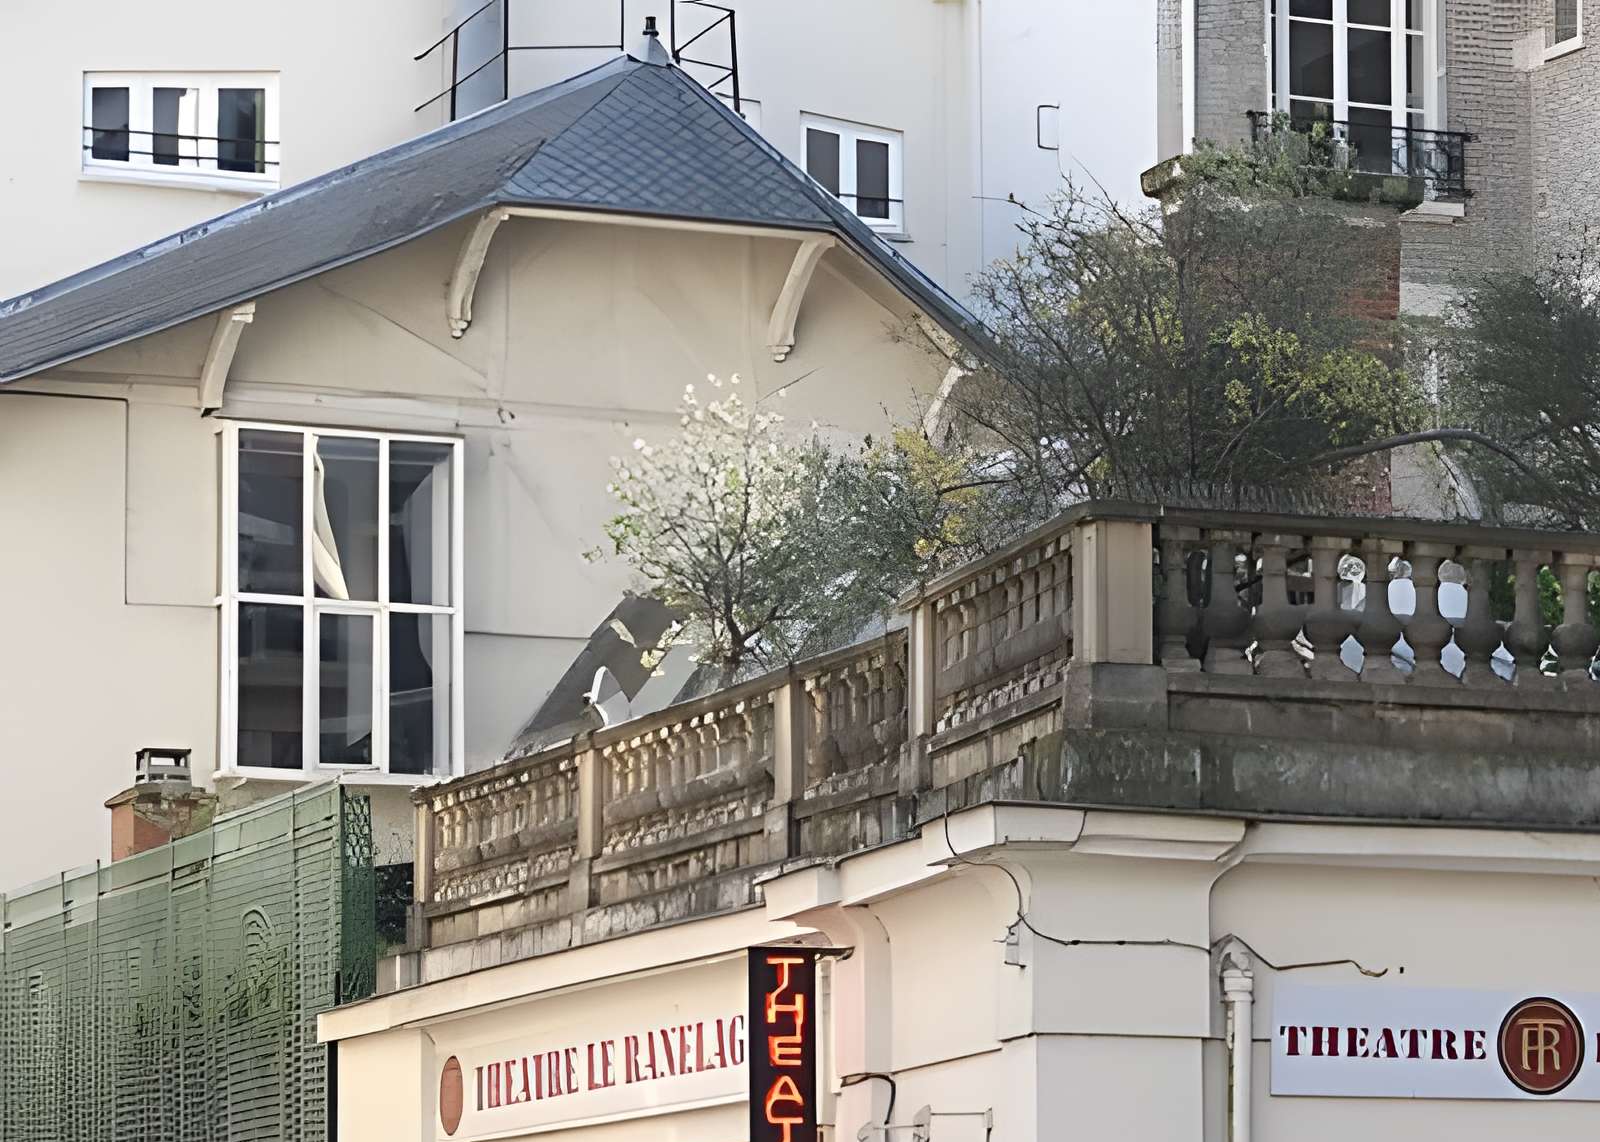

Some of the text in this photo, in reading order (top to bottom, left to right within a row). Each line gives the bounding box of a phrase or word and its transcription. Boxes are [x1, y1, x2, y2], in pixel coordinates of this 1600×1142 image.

[1279, 1025, 1487, 1060] THEATRE
[474, 1047, 579, 1112] THEATRE
[587, 1039, 616, 1091] LE
